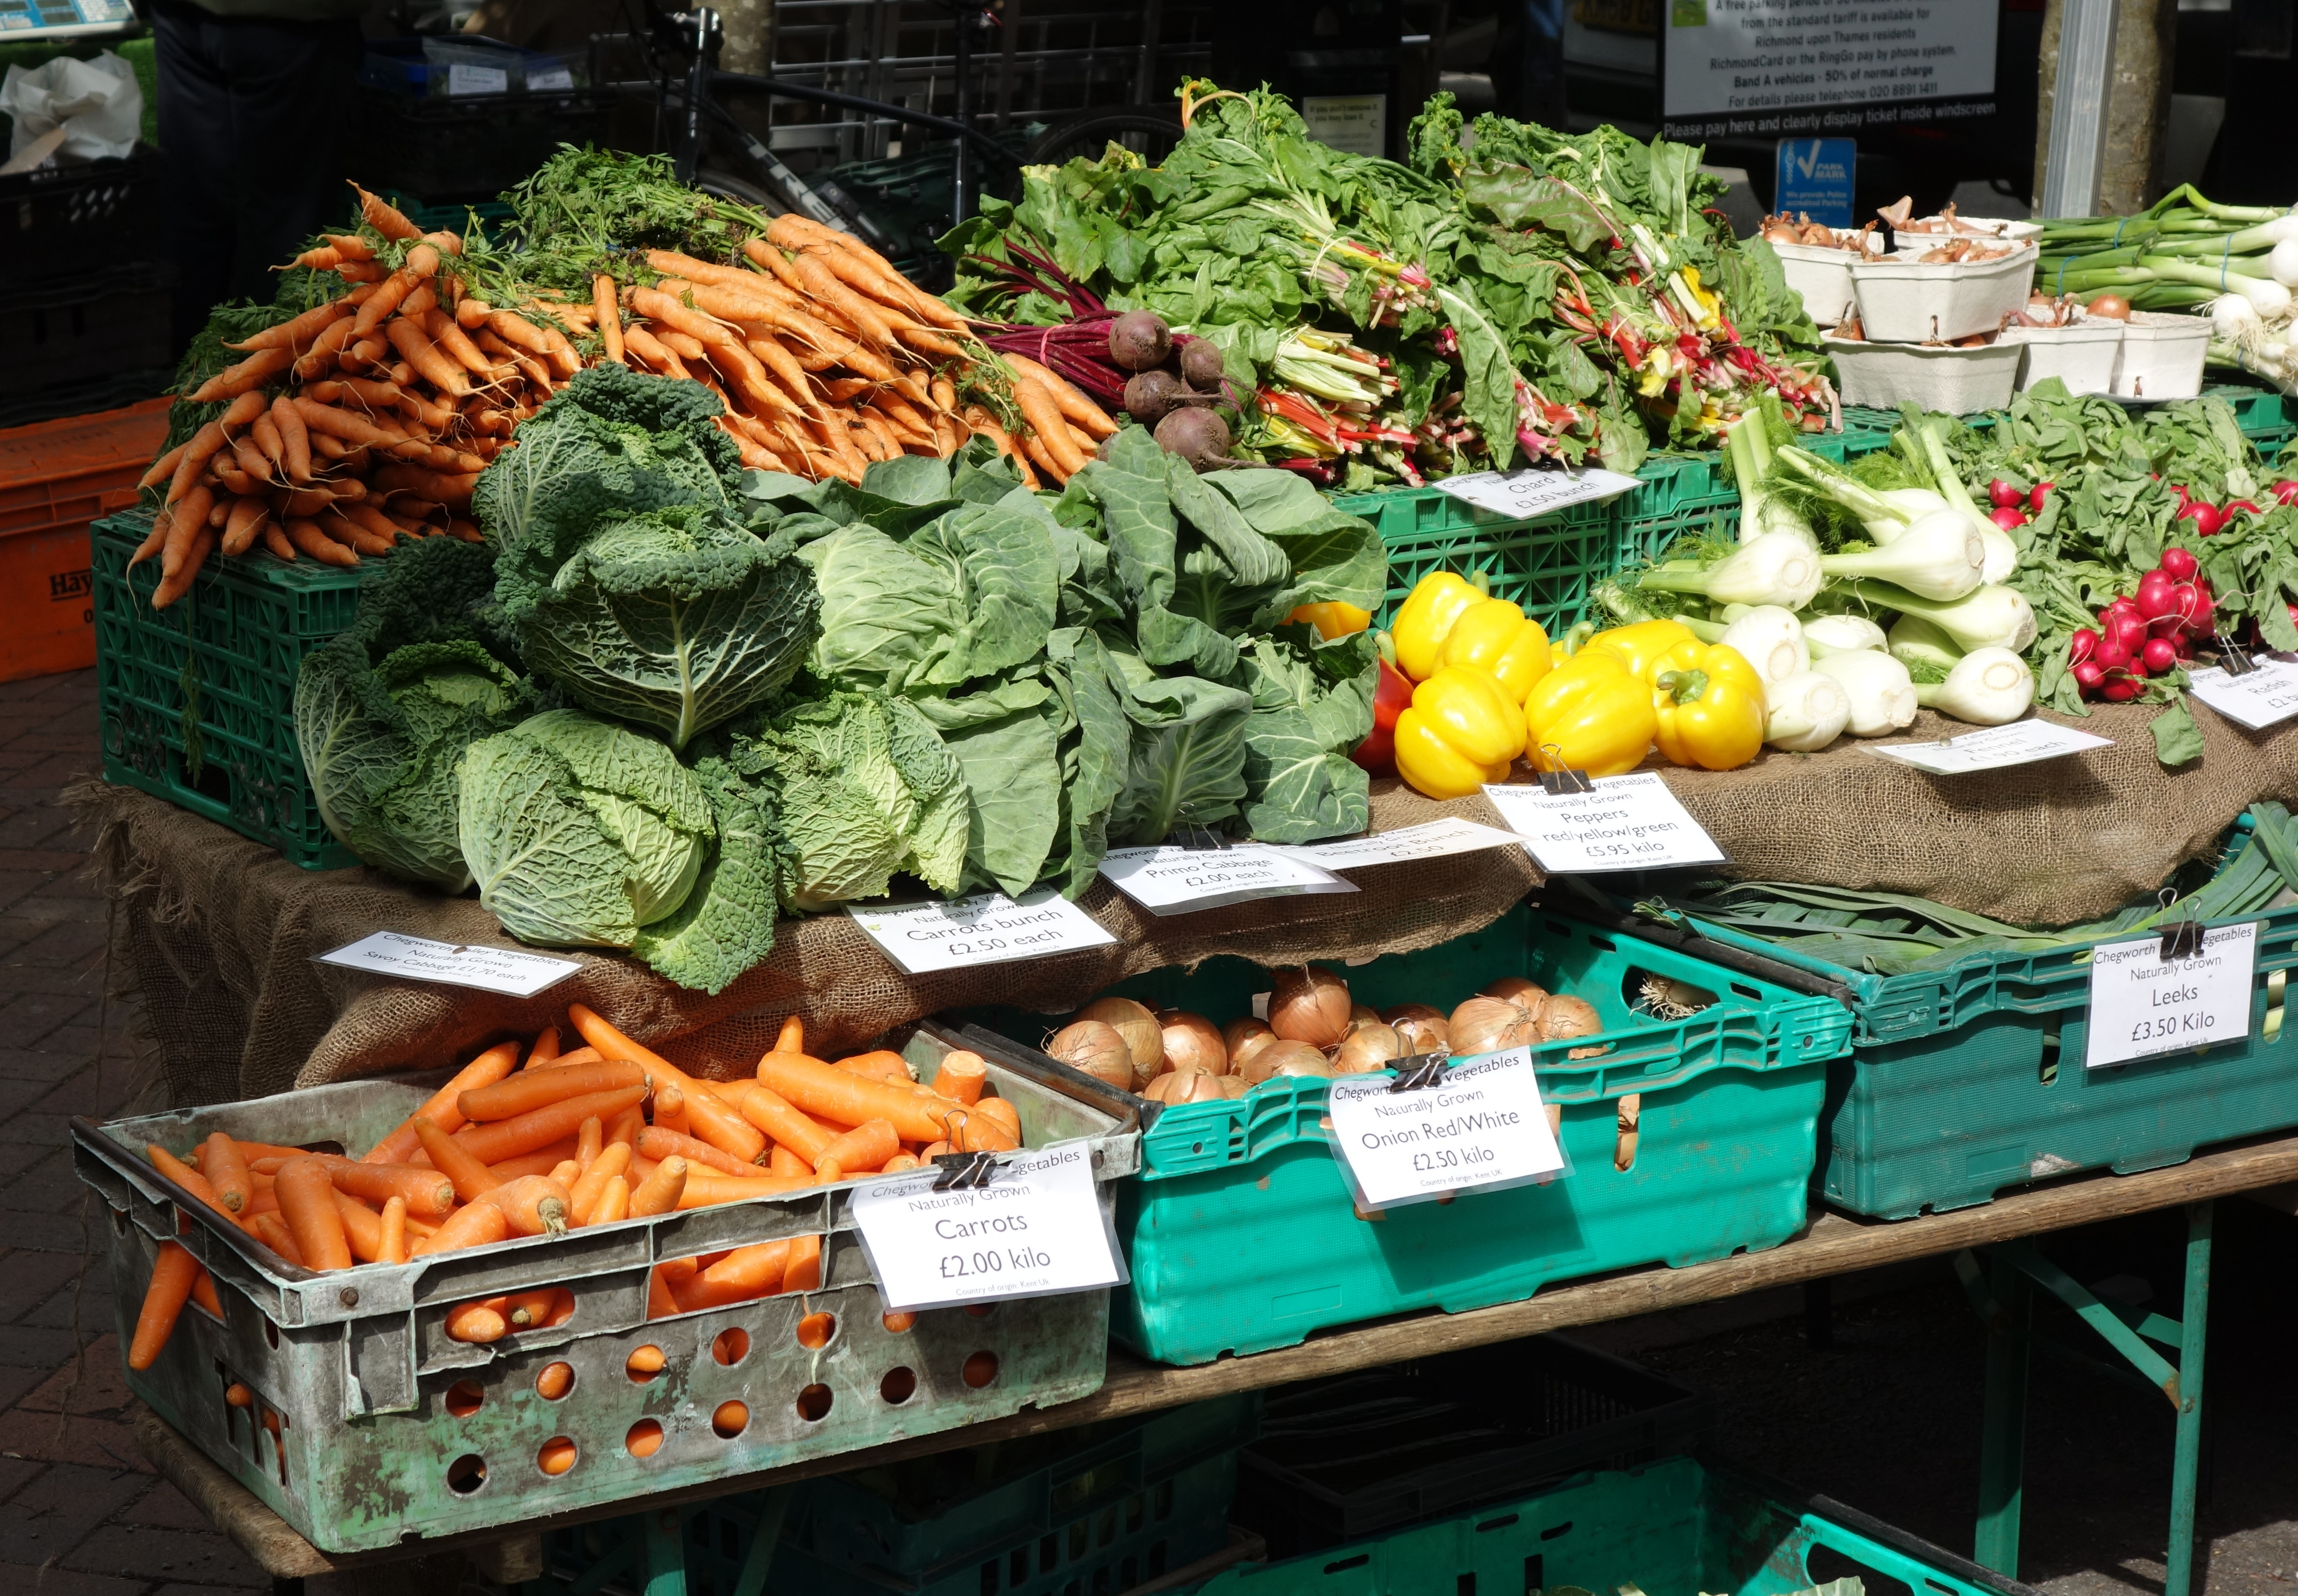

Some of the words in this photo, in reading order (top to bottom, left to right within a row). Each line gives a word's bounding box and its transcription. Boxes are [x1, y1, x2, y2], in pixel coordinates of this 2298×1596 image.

[1749, 0, 1785, 11] parking
[1741, 18, 1765, 29] from
[1769, 15, 1783, 27] the
[1787, 13, 1830, 26] standard
[1833, 10, 1858, 23] tariff
[1861, 10, 1868, 22] is
[1872, 8, 1913, 22] available
[1916, 6, 1930, 19] for
[1756, 34, 1804, 48] Richmond
[1807, 34, 1831, 46] upon
[1834, 30, 1870, 43] Thames
[1873, 26, 1916, 40] residents
[1711, 54, 1784, 70] RichmondCard
[1787, 54, 1797, 65] or
[1801, 52, 1816, 64] the
[1820, 50, 1854, 64] RingGo
[1858, 50, 1874, 62] pay
[1878, 47, 1888, 61] by
[1891, 46, 1920, 60] phone
[1922, 44, 1957, 58] system.
[1734, 76, 1760, 88] Band
[1763, 74, 1771, 86] A
[1775, 73, 1816, 85] vehicles
[1826, 69, 1847, 82] 50%
[1851, 68, 1861, 80] of
[1864, 66, 1898, 79] normal
[1901, 64, 1934, 79] charge
[1729, 95, 1745, 108] For
[1748, 94, 1782, 106] details
[1785, 92, 1816, 105] please
[1819, 89, 1867, 102] telephone
[1870, 85, 1890, 97] 020
[1893, 83, 1916, 96] 8891
[1919, 82, 1938, 95] 1411
[1664, 122, 1703, 138] Please
[1706, 122, 1727, 137] pay
[1730, 118, 1756, 133] here
[1758, 116, 1780, 130] and
[1783, 113, 1821, 130] clearly
[1824, 110, 1863, 128] display
[1866, 107, 1897, 123] ticket
[1901, 105, 1933, 120] inside
[1935, 102, 1996, 118] windscreen
[1814, 170, 1847, 178] MARK
[1508, 476, 1557, 494] Chard
[1515, 495, 1557, 509] £2.50
[1551, 482, 1600, 497] bunch
[2216, 674, 2256, 689] Naturally
[2252, 668, 2282, 679] Grown
[2247, 679, 2293, 695] Radish
[2268, 698, 2289, 709] £2
[1985, 731, 2025, 741] Grown
[1993, 724, 2028, 733] Salads
[1963, 738, 2027, 754] Fennel
[2025, 742, 2067, 752] each
[1489, 788, 1548, 798] Chegwort
[1533, 798, 1586, 809] Naturally
[1590, 792, 1633, 805] Grown
[1560, 809, 1629, 825] Peppers
[1327, 840, 1383, 850] Naturally
[1385, 832, 1429, 841] Grown
[1543, 820, 1678, 843] red/yellow/green
[1315, 843, 1410, 857] Beetroot
[1408, 831, 1474, 845] Bunch
[1390, 845, 1444, 857] £2.50
[1586, 844, 1630, 858] £5.95
[1632, 841, 1664, 853] kilo
[1144, 855, 1200, 865] Naturally
[1146, 866, 1200, 878] Primo
[1202, 860, 1273, 870] Cabbage
[1185, 873, 1231, 886] £2.00
[1236, 870, 1274, 879] each
[864, 904, 938, 918] Chegworth
[913, 911, 974, 923] Naturally
[977, 903, 1024, 915] Grown
[907, 923, 993, 941] Carrots
[994, 910, 1063, 929] bunch
[383, 935, 453, 952] Chegworth
[497, 951, 563, 966] Vegetables
[948, 938, 1007, 956] £2.50
[1014, 929, 1063, 945] each
[2094, 944, 2156, 964] Chegworth
[2203, 927, 2252, 947] egetables
[363, 951, 402, 962] Savoy
[403, 959, 456, 970] Cabbage
[458, 966, 496, 975] £1.70
[497, 973, 526, 981] each
[407, 950, 466, 963] Naturally
[468, 957, 513, 968] Grown
[2131, 961, 2179, 981] Naturally
[2183, 955, 2222, 971] Grown
[2152, 984, 2198, 1007] Leeks
[2131, 1017, 2177, 1042] £3.50
[2182, 1011, 2215, 1032] Kilo
[2135, 1049, 2159, 1057] Country
[2167, 1043, 2184, 1051] origin:
[1335, 1085, 1392, 1102] Chegwort
[1375, 1098, 1433, 1118] Naturally
[1438, 1089, 1484, 1108] Grown
[1362, 1129, 1420, 1150] Onion
[1421, 1109, 1521, 1141] Red/White
[1413, 1151, 1458, 1172] £2.50
[1461, 1146, 1495, 1164] kilo
[1420, 1178, 1446, 1188] Country
[1448, 1175, 1456, 1183] of
[1457, 1173, 1474, 1183] origin:
[1475, 1171, 1491, 1180] Kent
[1491, 1168, 1503, 1177] UK
[909, 1193, 974, 1212] Naturally
[979, 1186, 1031, 1201] Grown
[935, 1214, 1028, 1240] Carrots
[939, 1250, 1002, 1278] £2.00
[1008, 1246, 1051, 1270] kilo
[956, 1287, 986, 1297] Country
[987, 1283, 996, 1291] of
[997, 1282, 1019, 1292] origin:
